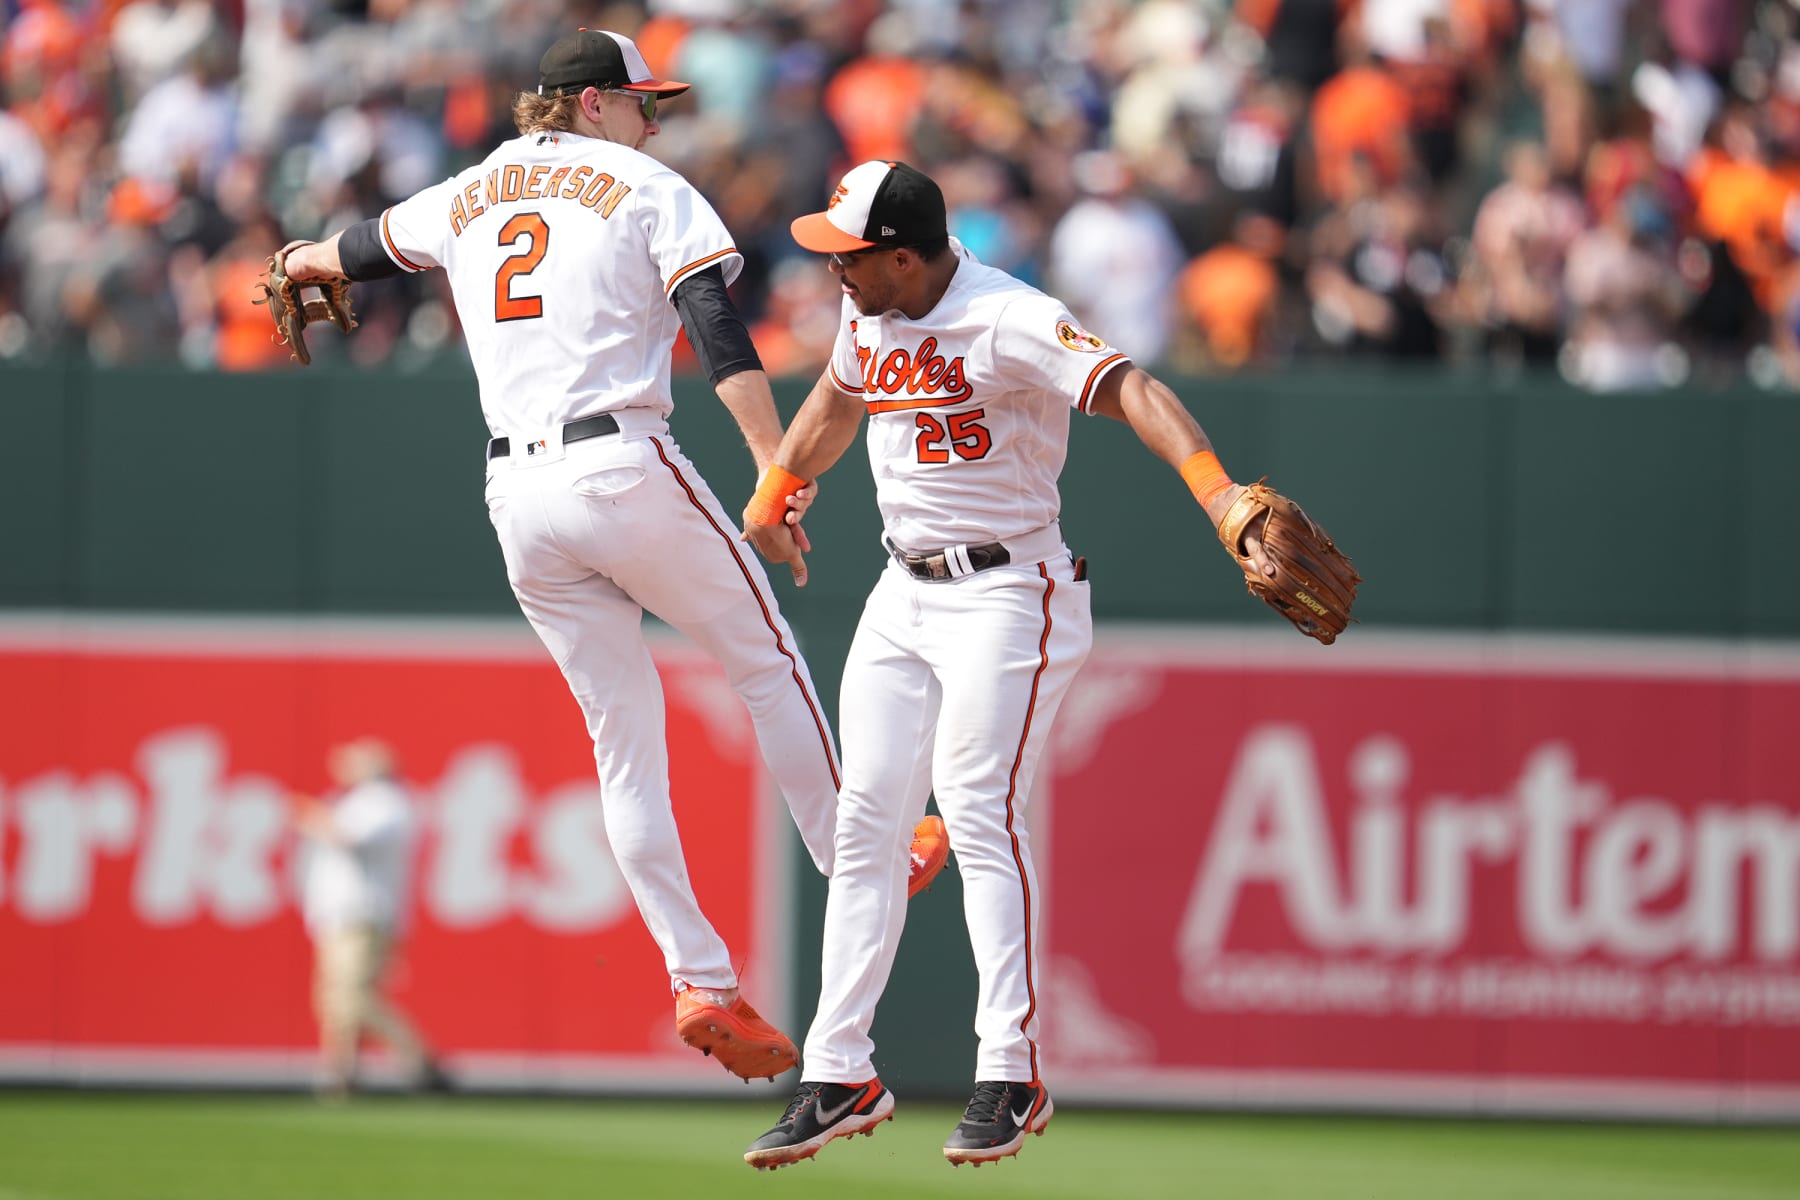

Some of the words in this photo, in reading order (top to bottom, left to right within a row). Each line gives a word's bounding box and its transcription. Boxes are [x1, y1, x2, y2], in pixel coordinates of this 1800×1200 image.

[449, 164, 631, 237] HENDERSON
[495, 212, 550, 323] 2
[915, 408, 992, 464] 25
